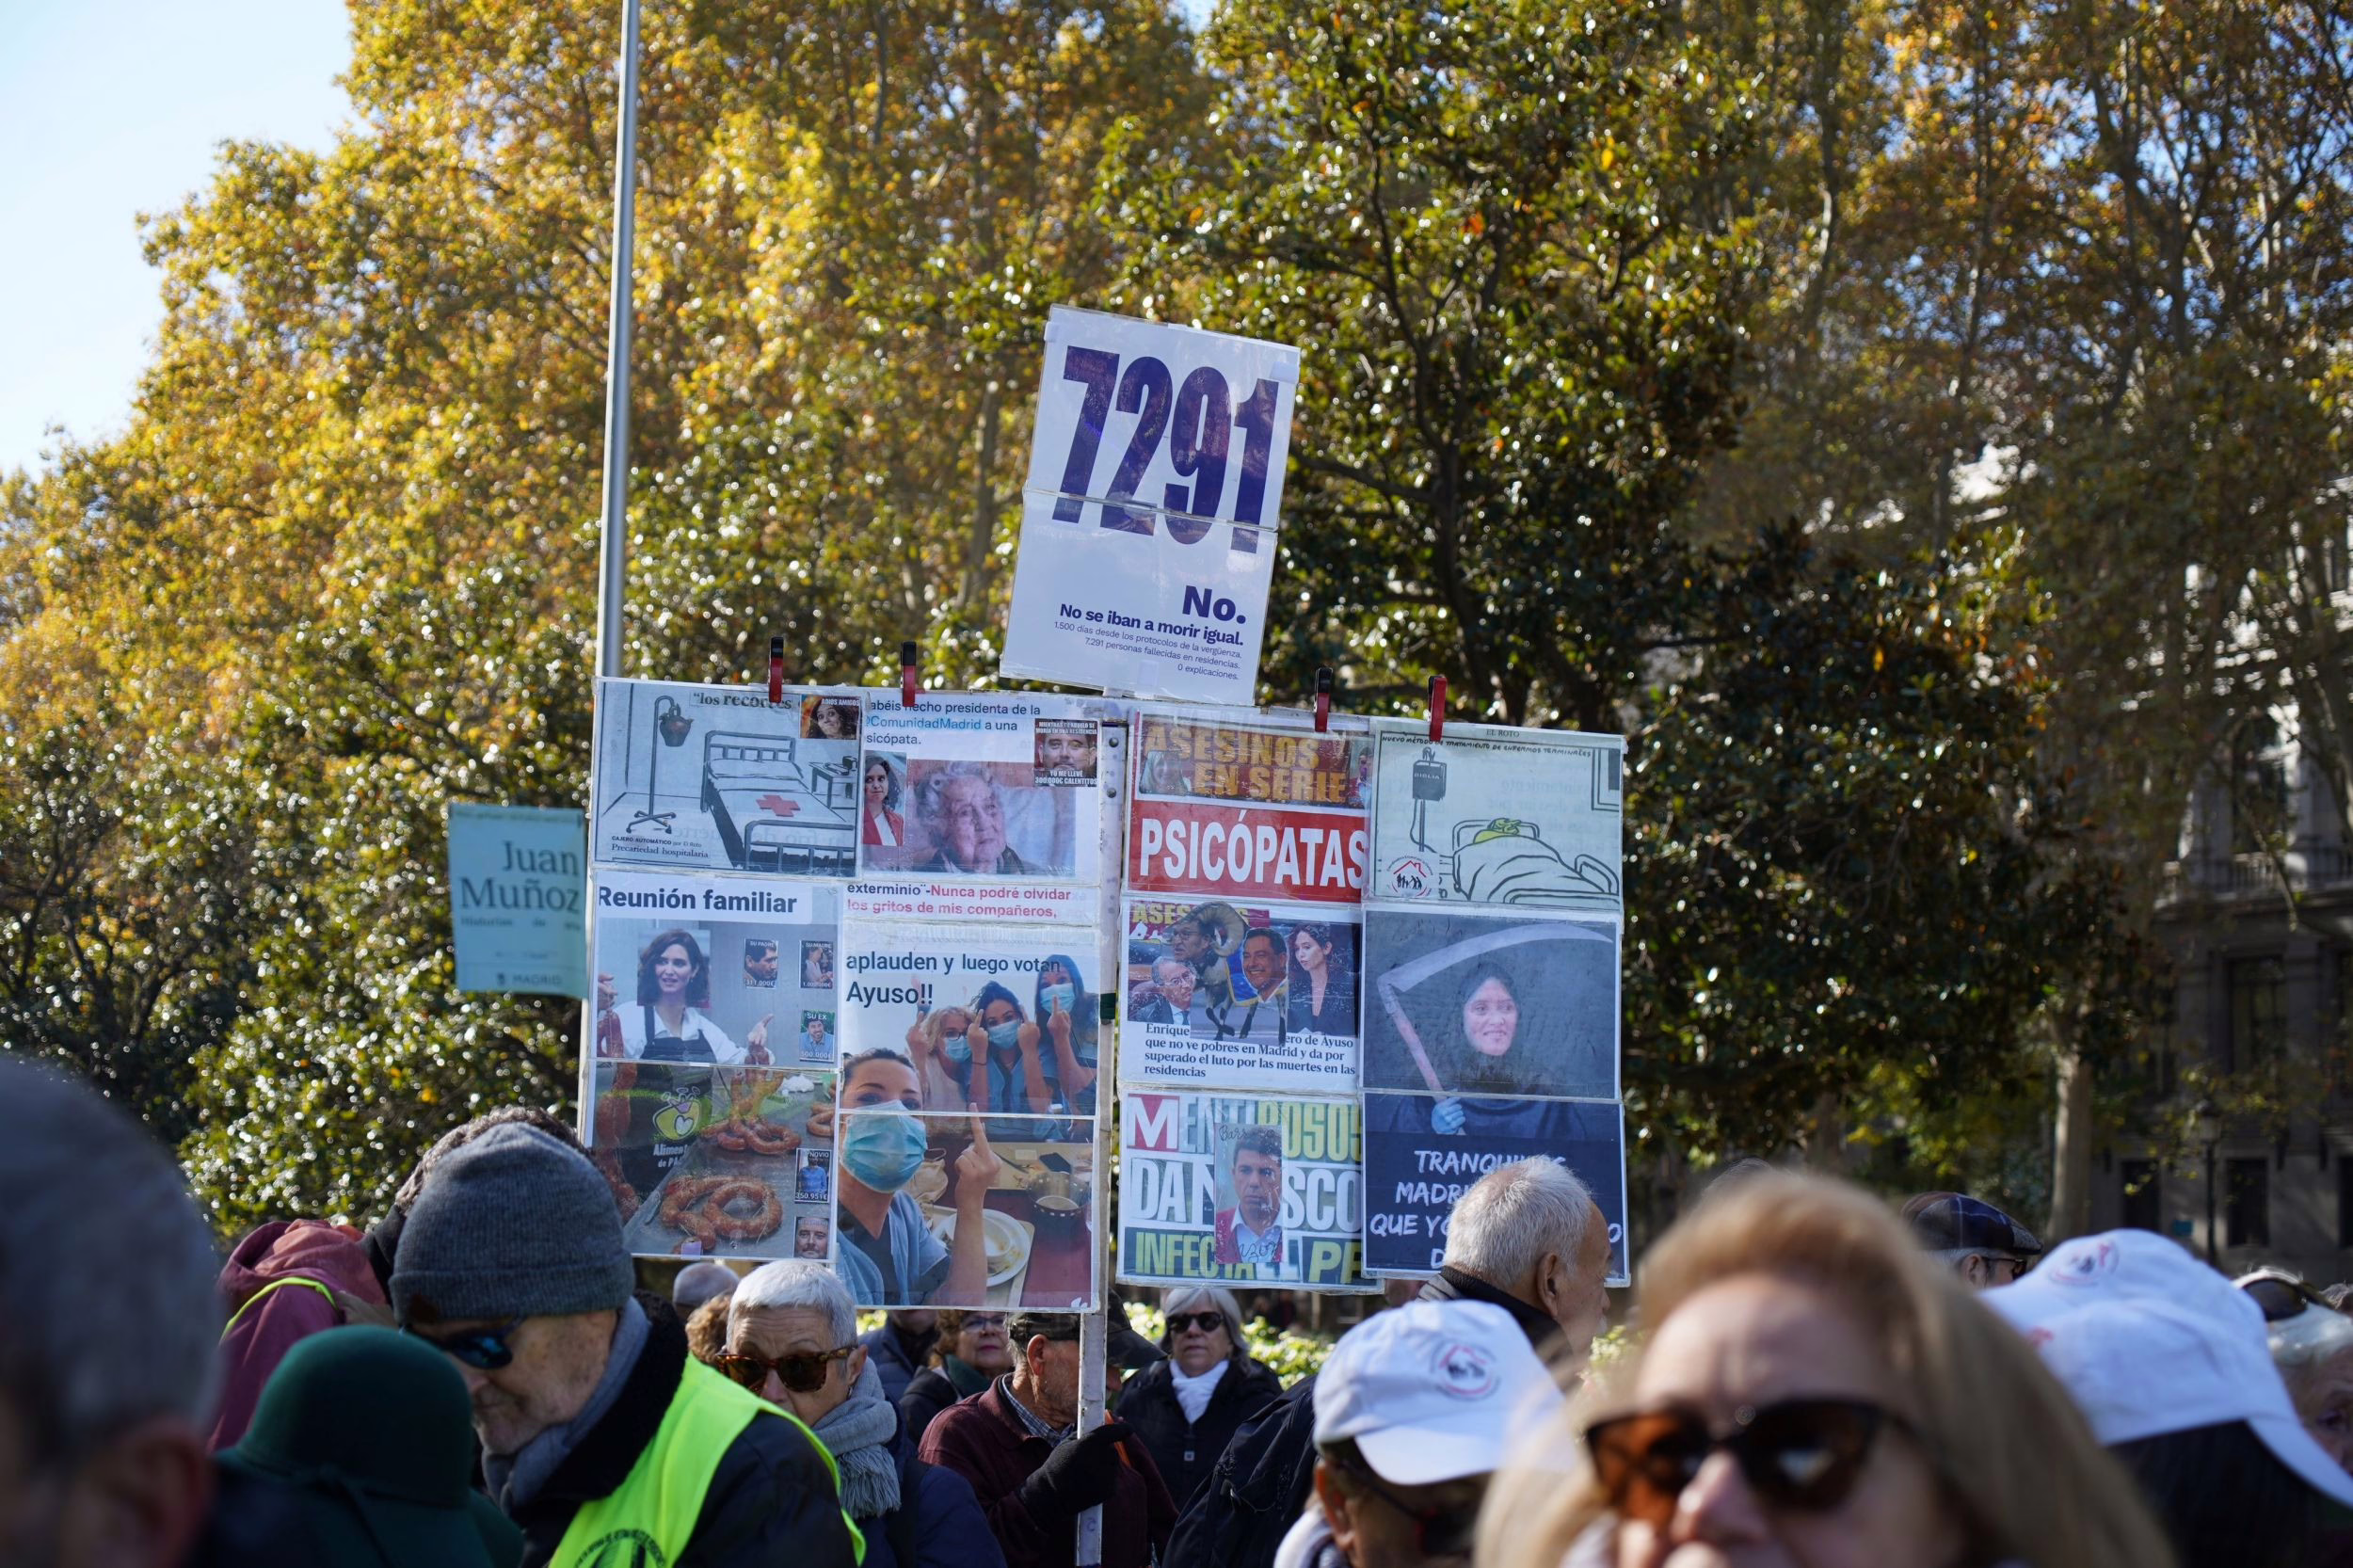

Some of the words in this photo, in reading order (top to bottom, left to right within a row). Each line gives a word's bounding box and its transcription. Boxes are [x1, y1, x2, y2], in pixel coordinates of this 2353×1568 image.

[1052, 345, 1279, 553] 7291
[1182, 584, 1246, 624] No.
[1060, 603, 1081, 618] No
[1085, 610, 1104, 622] se
[1107, 610, 1141, 629] iban
[1144, 619, 1154, 631] a
[1157, 623, 1200, 639] morir
[1203, 626, 1243, 646] igual.
[1054, 621, 1075, 632] 1.500
[1077, 624, 1094, 634] días
[1095, 628, 1120, 639] desde
[1122, 632, 1134, 641] los
[1136, 634, 1178, 648] protocolos
[1179, 641, 1191, 650] de
[1192, 643, 1199, 651] la
[1201, 645, 1242, 659] vergüenza.
[1085, 637, 1104, 648] 7.291
[1105, 641, 1143, 653] personas
[1144, 646, 1181, 660] fallecidas
[1194, 654, 1241, 669] residencias.
[1185, 664, 1239, 680] explicaciones.
[871, 699, 902, 712] abéis
[945, 701, 1009, 716] presidenta
[1012, 703, 1027, 715] de
[1031, 704, 1041, 715] la
[984, 722, 992, 730] a
[995, 721, 1017, 731] una
[1497, 729, 1520, 738] ROTO
[866, 732, 922, 746] sicópata.
[1144, 725, 1320, 769] ASESINOS
[1446, 741, 1490, 749] TRATAMIENTO
[1544, 748, 1591, 758] TERMINALES
[1194, 761, 1241, 796] EN
[1249, 767, 1348, 804] SERIE
[503, 840, 580, 877] Juan
[612, 843, 659, 855] Precariedad
[662, 847, 709, 858] hospitalaria
[1140, 809, 1369, 889] PSICÓPATAS
[459, 876, 581, 915] Muñoz
[599, 886, 696, 909] Reunión
[703, 889, 797, 913] familiar
[847, 899, 868, 911] los
[872, 901, 913, 915] gritos
[917, 902, 934, 914] de
[937, 903, 963, 915] mis
[979, 887, 1019, 902] podré
[1023, 888, 1071, 901] olvidar
[846, 951, 937, 973] aplauden
[943, 956, 954, 975] y
[962, 953, 1009, 975] luego
[1014, 956, 1061, 973] votan
[846, 981, 934, 1009] Ayuso!!
[1145, 1023, 1190, 1037] Enrique
[1305, 1034, 1319, 1046] de
[1321, 1035, 1353, 1048] Ayuso
[1145, 1038, 1166, 1049] que
[1169, 1039, 1183, 1048] no
[1186, 1041, 1199, 1050] ve
[1201, 1041, 1240, 1053] pobres
[1241, 1045, 1256, 1054] en
[1258, 1044, 1298, 1057] Madrid
[1300, 1049, 1307, 1060] y
[1309, 1048, 1322, 1060] da
[1325, 1051, 1345, 1062] por
[1144, 1051, 1196, 1065] superado
[1198, 1054, 1209, 1064] el
[1211, 1054, 1235, 1066] luto
[1237, 1059, 1257, 1069] por
[1258, 1057, 1274, 1069] las
[1276, 1061, 1321, 1073] muertes
[1323, 1064, 1338, 1074] en
[1340, 1064, 1355, 1075] las
[1144, 1064, 1207, 1078] residencias
[1369, 1212, 1418, 1238] QUE
